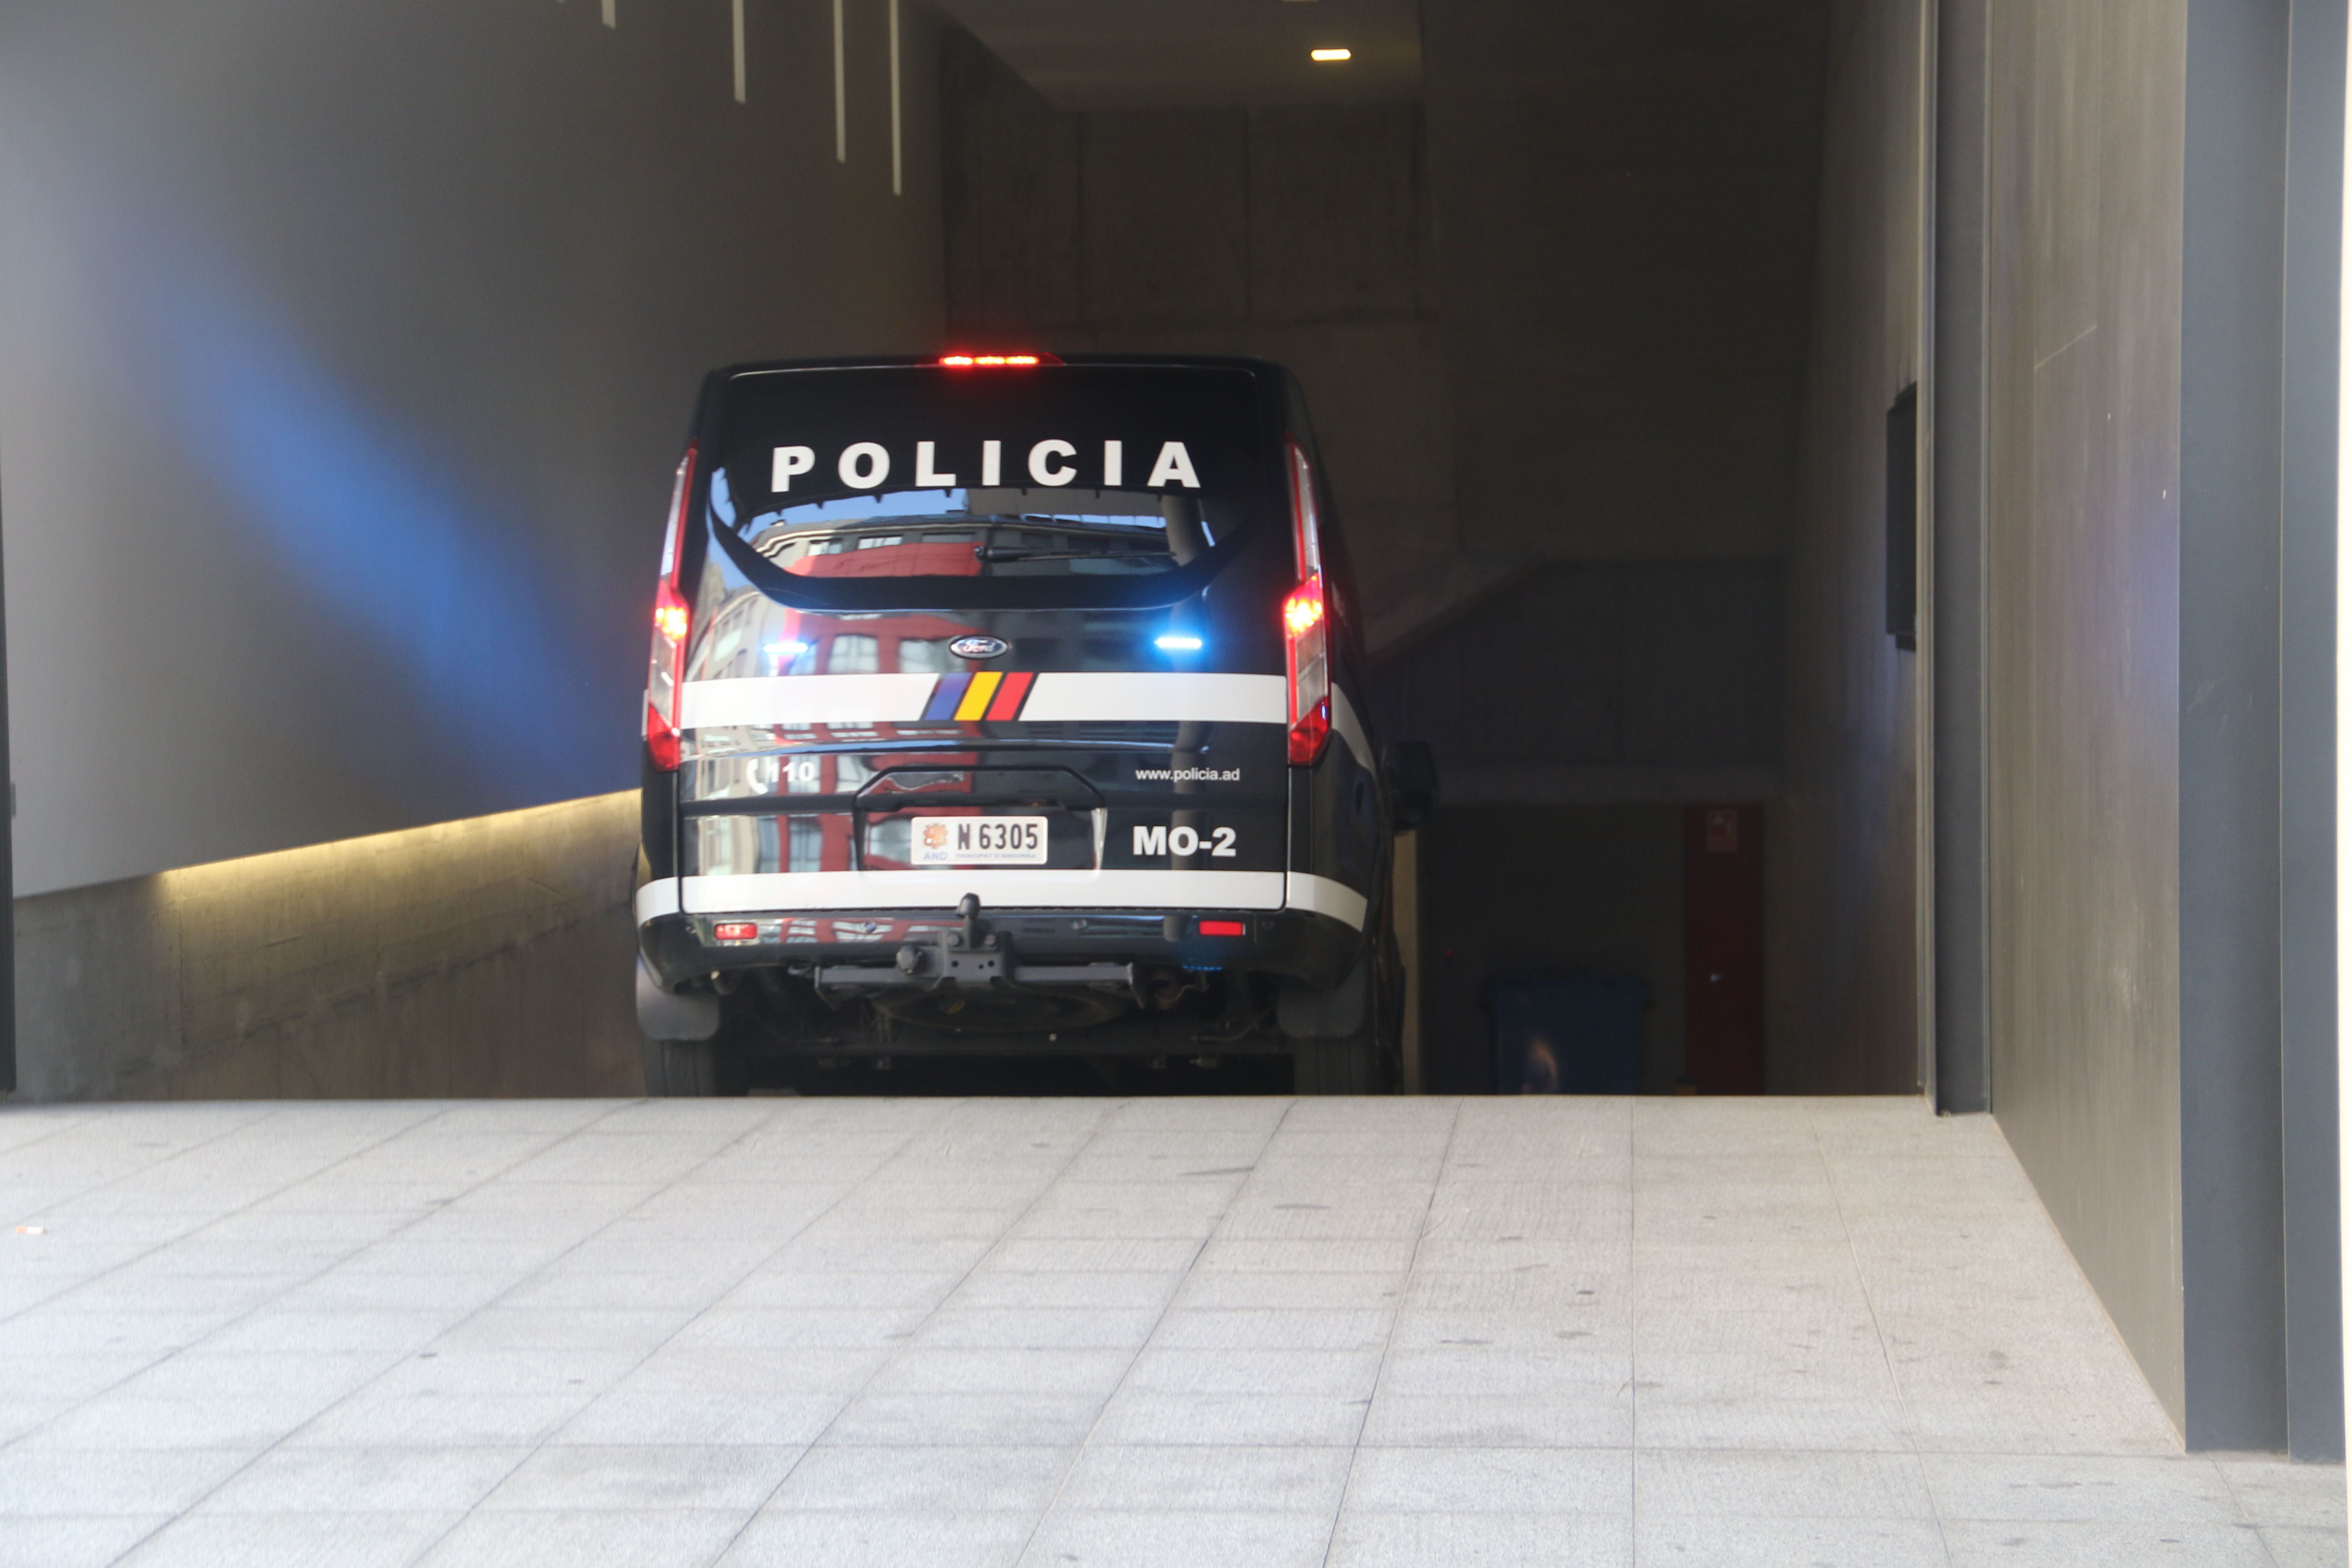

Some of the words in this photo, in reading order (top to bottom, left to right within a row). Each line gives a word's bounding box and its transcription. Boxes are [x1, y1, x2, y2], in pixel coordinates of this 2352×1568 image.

[772, 439, 1200, 492] POLICIA
[769, 761, 815, 782] 110
[1135, 767, 1240, 782] www.policia.ad
[958, 823, 970, 850] N
[979, 823, 1038, 850] 6305
[1133, 825, 1237, 857] MO-2
[924, 851, 947, 860] AND
